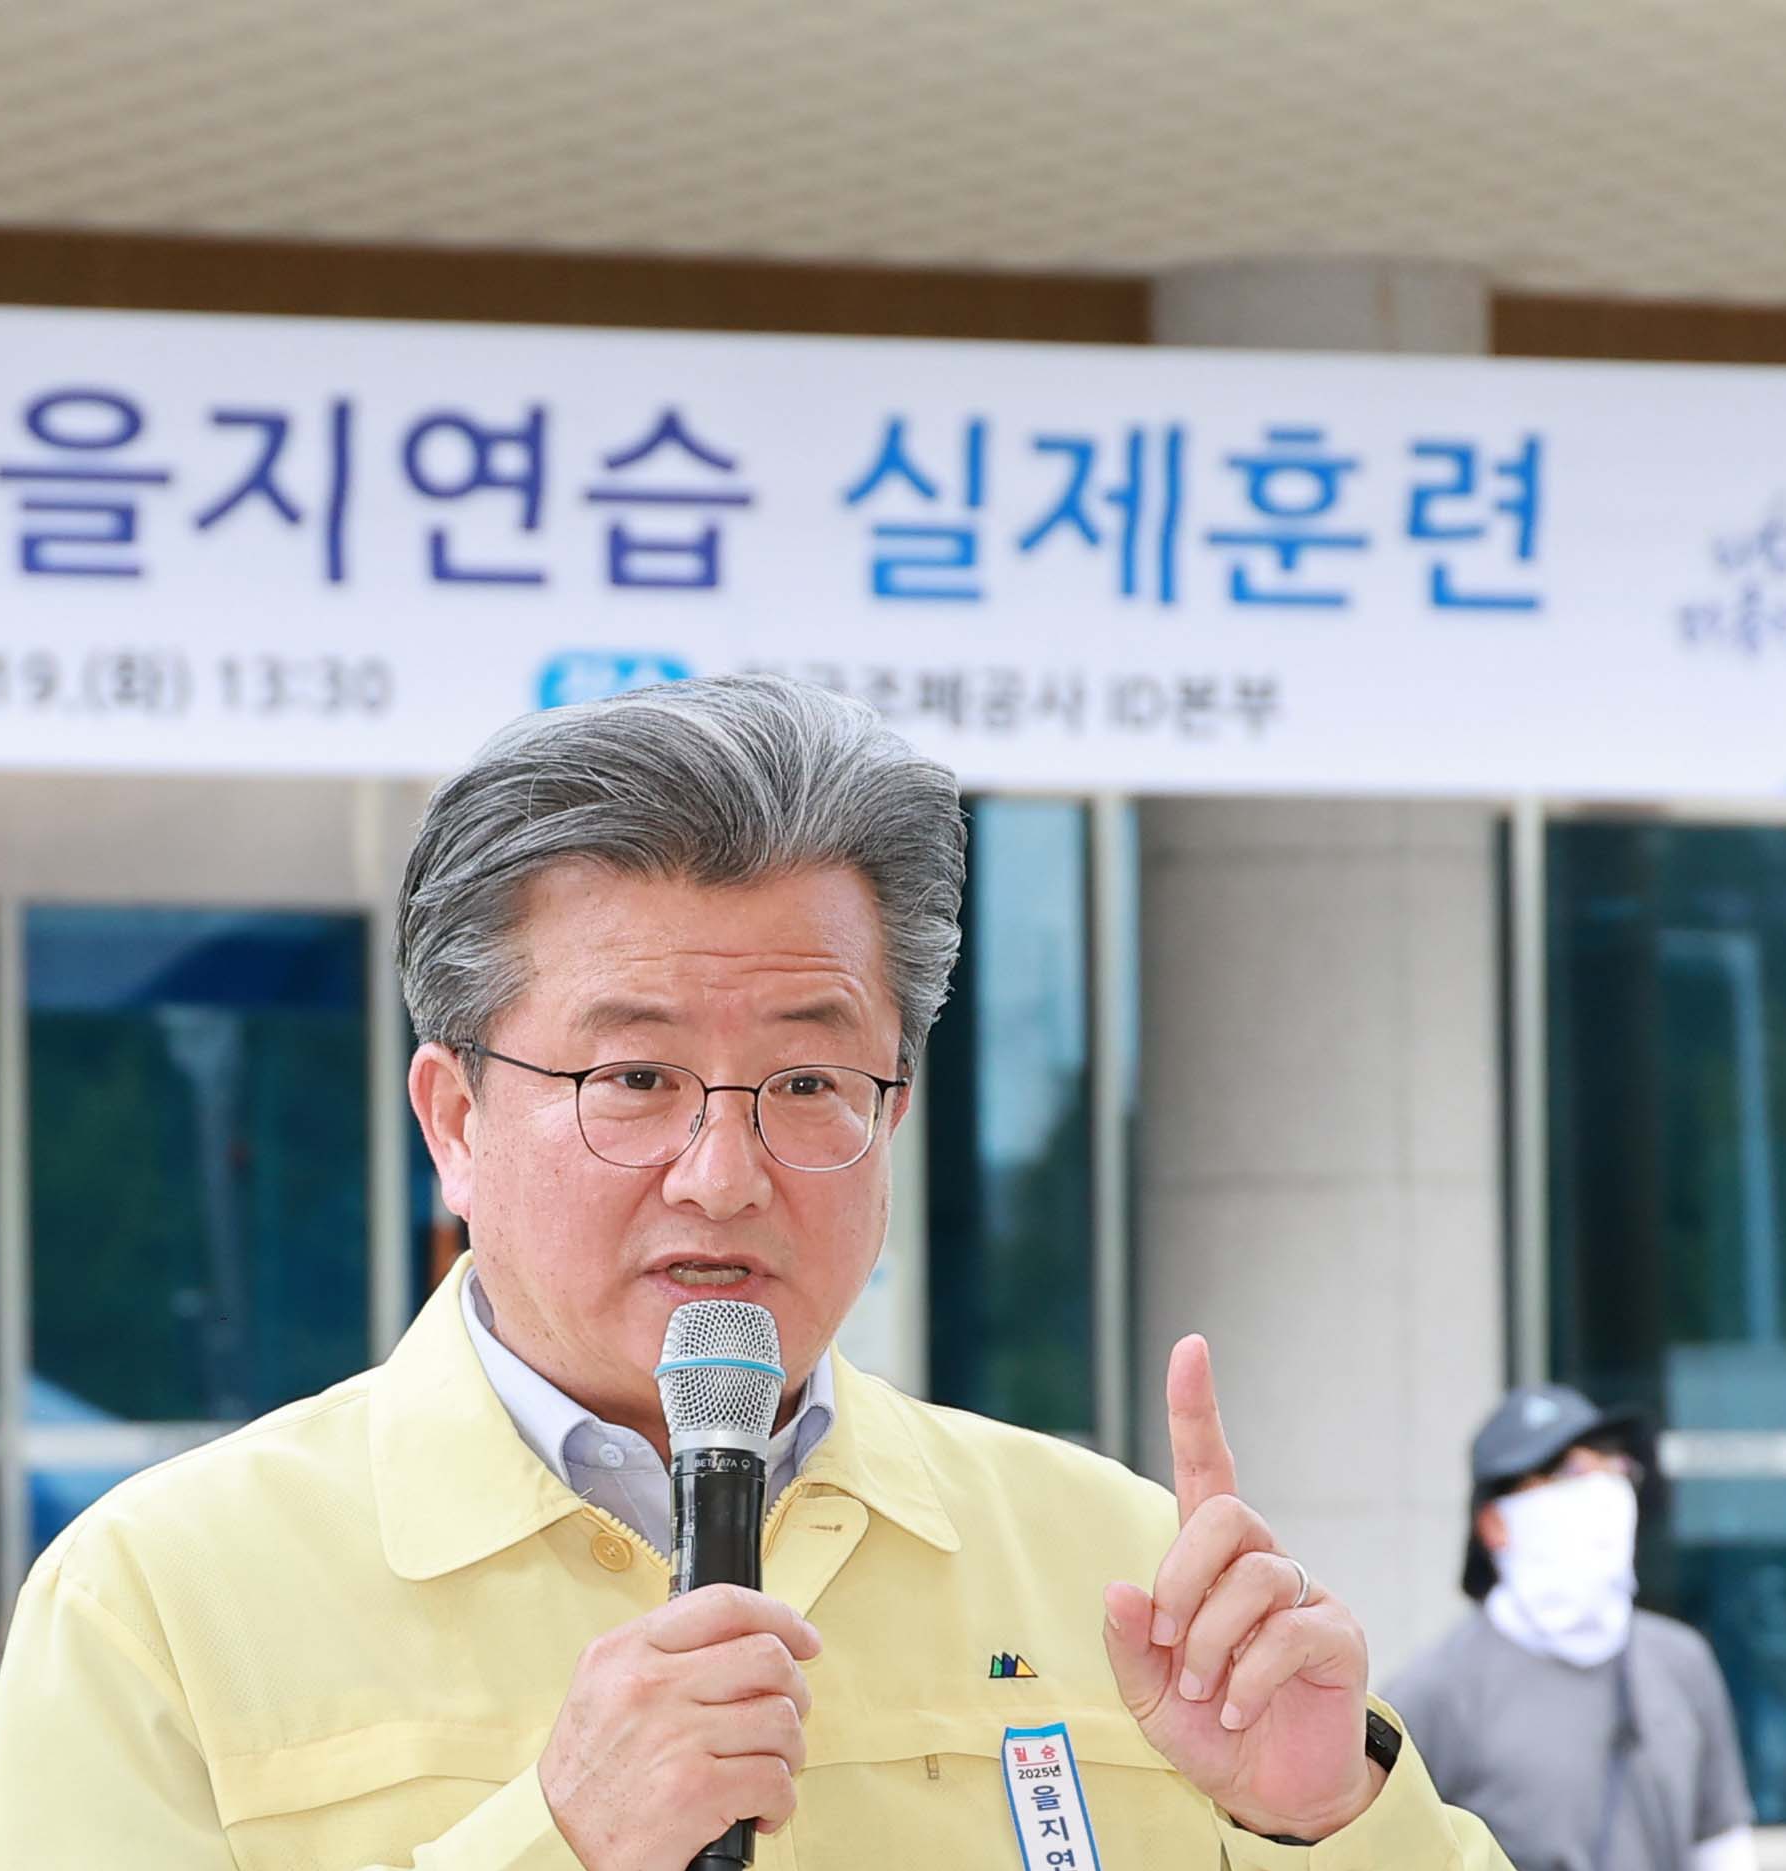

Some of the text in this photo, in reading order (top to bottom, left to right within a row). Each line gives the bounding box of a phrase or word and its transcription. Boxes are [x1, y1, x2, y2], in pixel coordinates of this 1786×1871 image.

[840, 415, 1546, 614] 실제훈련
[220, 656, 392, 715] 13:30
[695, 1458, 717, 1468] BET
[1017, 1764, 1062, 1780] 2025년
